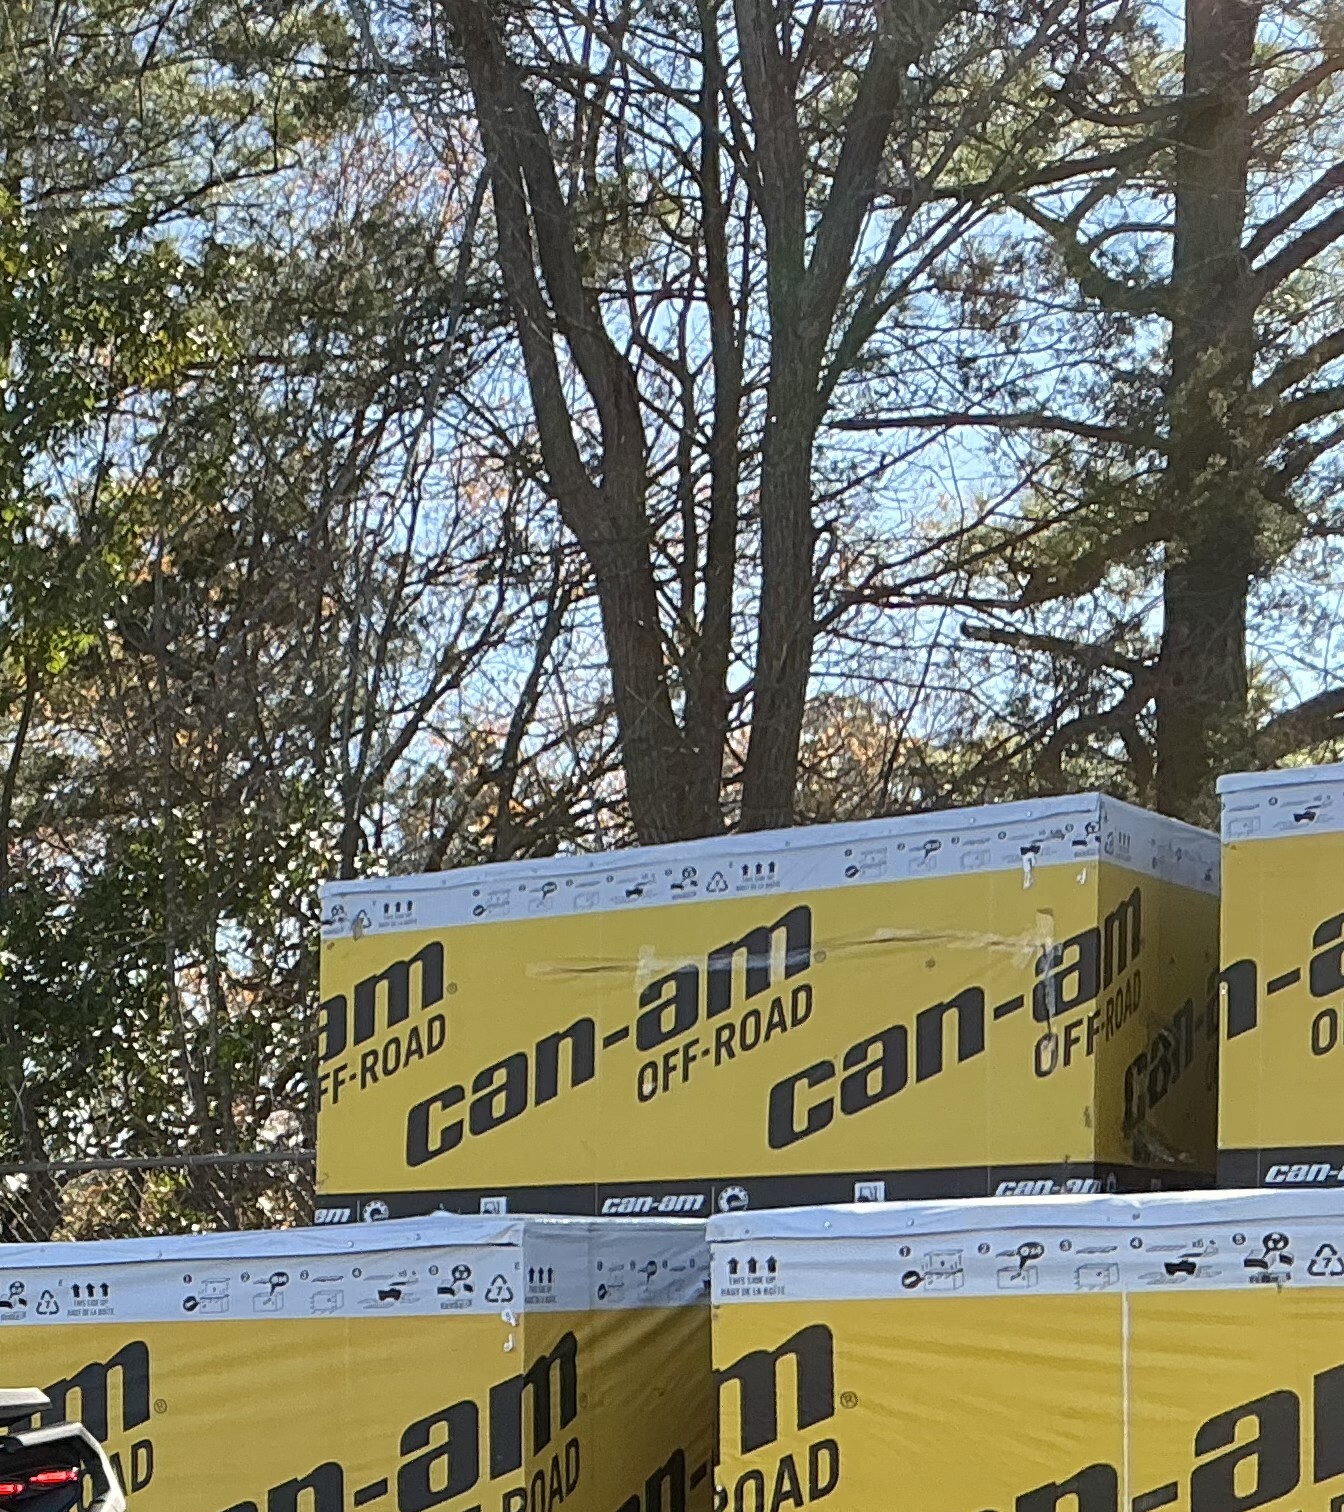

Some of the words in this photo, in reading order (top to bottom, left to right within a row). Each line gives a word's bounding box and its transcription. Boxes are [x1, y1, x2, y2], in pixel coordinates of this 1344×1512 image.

[406, 905, 811, 1168] can-am
[638, 984, 812, 1104] OFF-ROAD
[768, 887, 1141, 1151] can-am
[1034, 969, 1141, 1079] OFF-ROAD
[602, 1194, 705, 1214] can-am
